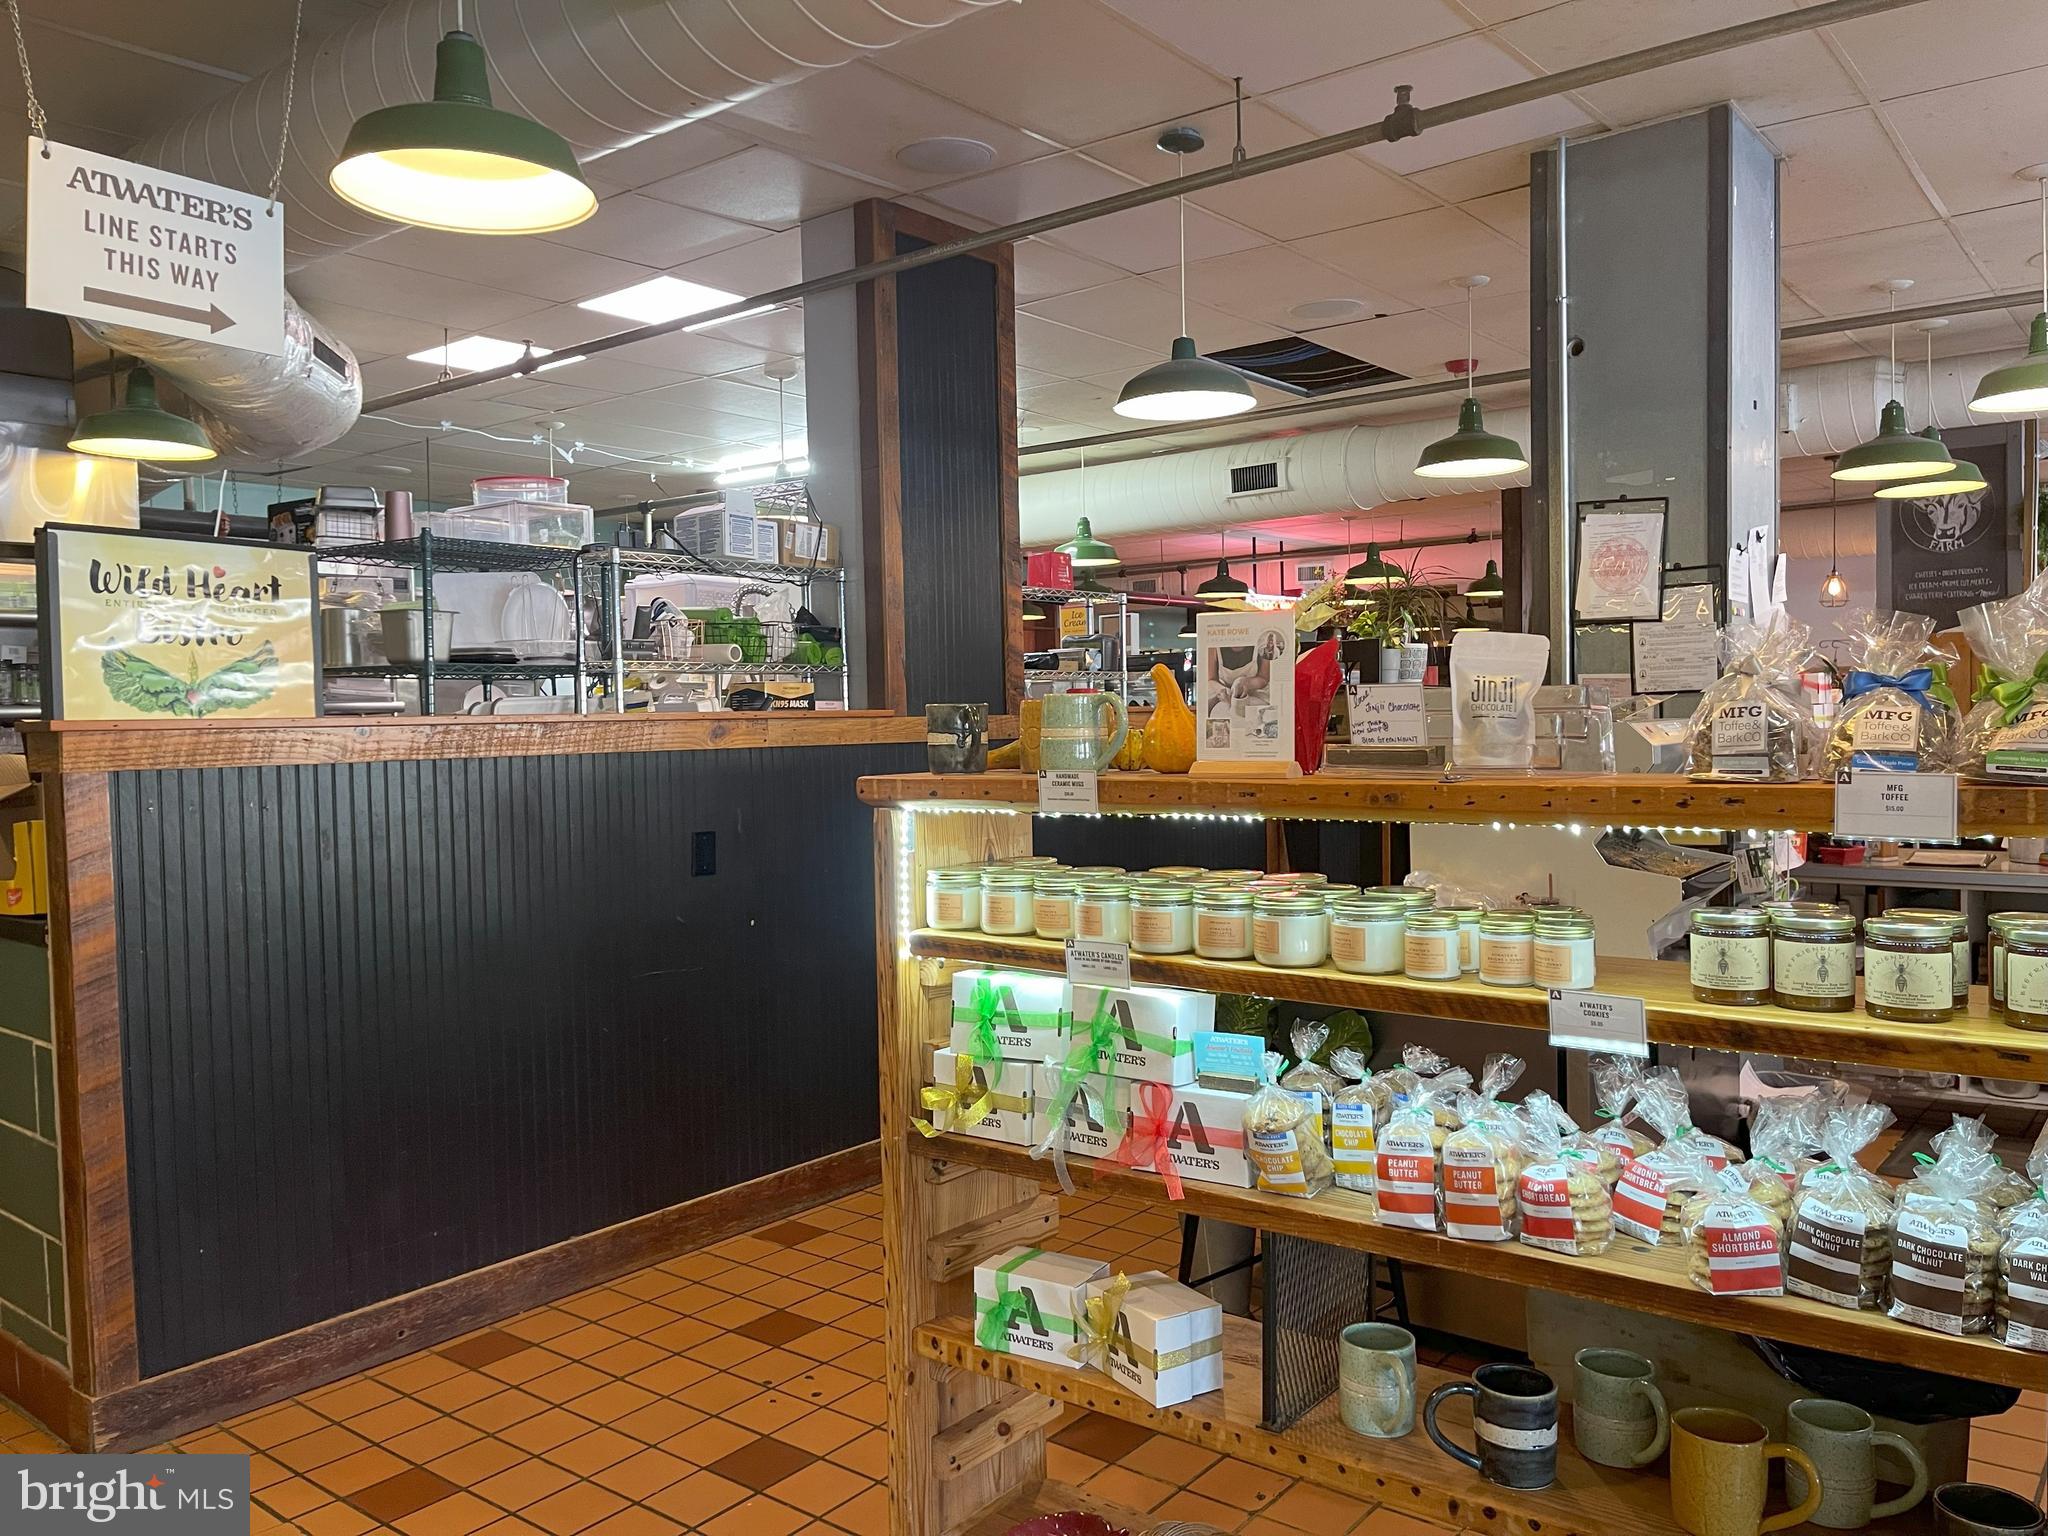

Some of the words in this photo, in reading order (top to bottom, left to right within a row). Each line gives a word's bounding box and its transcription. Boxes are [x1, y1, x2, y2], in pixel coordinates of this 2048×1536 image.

[66, 166, 253, 231] ATWATER'S
[84, 209, 139, 243] LINE
[149, 225, 238, 265] STARTS
[104, 248, 160, 281] THIS
[170, 262, 219, 292] WAY
[1929, 538, 1965, 552] FARM
[89, 558, 177, 597] Wild
[186, 565, 282, 604] Heart
[1071, 611, 1083, 619] Ice
[1471, 675, 1513, 703] jinji
[790, 700, 808, 708] MASK
[1470, 703, 1513, 712] CHOCOLATE
[1718, 706, 1762, 719] MFG
[1863, 710, 1913, 721] MFG
[1881, 793, 1909, 801] TOFFEE
[1071, 950, 1100, 958] ATWATER'S
[1100, 952, 1124, 961] CANDLES
[1579, 1001, 1613, 1012] ATWATER'S
[1583, 1009, 1610, 1019] COOKIES
[1167, 1101, 1216, 1156] A
[1335, 1129, 1367, 1138] CHOCOLATE
[1344, 1138, 1359, 1147] CHIP
[1385, 1139, 1424, 1148] ATWATER'S
[1449, 1150, 1486, 1159] ATWATER'S
[1266, 1164, 1284, 1172] CHIP
[1388, 1158, 1418, 1168] PEANUT
[1389, 1169, 1418, 1178] BUTTER
[1453, 1170, 1482, 1179] PEANUT
[1453, 1180, 1482, 1190] BUTTER
[1623, 1170, 1666, 1193] SHORTBREAD
[1522, 1190, 1566, 1203] SHORTBREAD
[1722, 1230, 1761, 1242] ALMOND
[1798, 1221, 1815, 1236] DARK
[1815, 1228, 1860, 1249] CHOCOLATE
[1711, 1239, 1773, 1253] SHORTBREAD
[1811, 1235, 1841, 1253] WALNUT
[1897, 1238, 1916, 1251] DARK
[1916, 1245, 1964, 1263] CHOCOLATE
[1911, 1253, 1944, 1269] WALNUT
[2012, 1257, 2035, 1270] DARK
